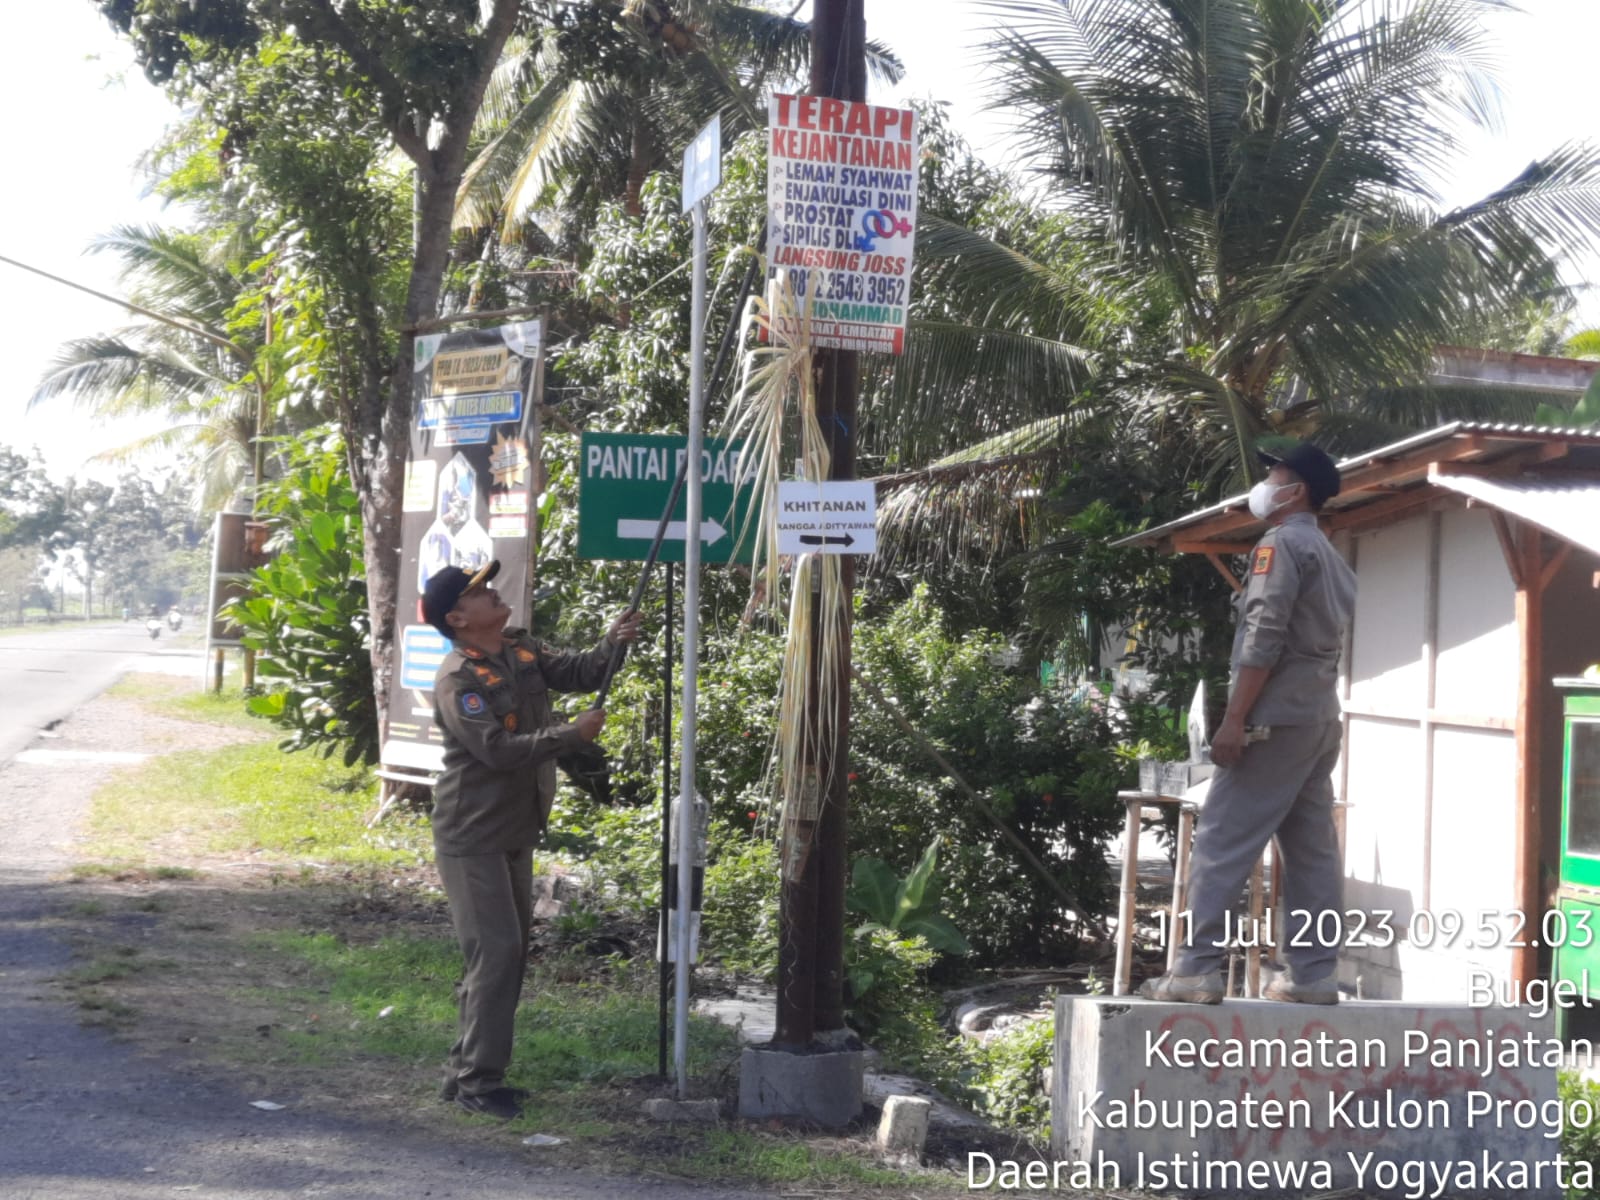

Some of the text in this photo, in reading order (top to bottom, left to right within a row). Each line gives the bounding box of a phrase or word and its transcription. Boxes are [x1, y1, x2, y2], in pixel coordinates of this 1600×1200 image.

[772, 93, 914, 141] TERAPI
[772, 127, 912, 171] KEJANTANAN
[786, 161, 913, 192] LEMAH SYAHWAT
[785, 181, 912, 211] ENJAKULASI DINI
[784, 202, 855, 228] PROSTAT
[782, 224, 861, 250] SIPILIS DLL
[773, 246, 906, 276] LANGSUNG JOSS
[789, 269, 824, 298] 082
[826, 272, 864, 302] 2543
[867, 276, 906, 306] 3952
[587, 445, 760, 485] PANTAI BDARA
[783, 501, 867, 512] KHITANAN
